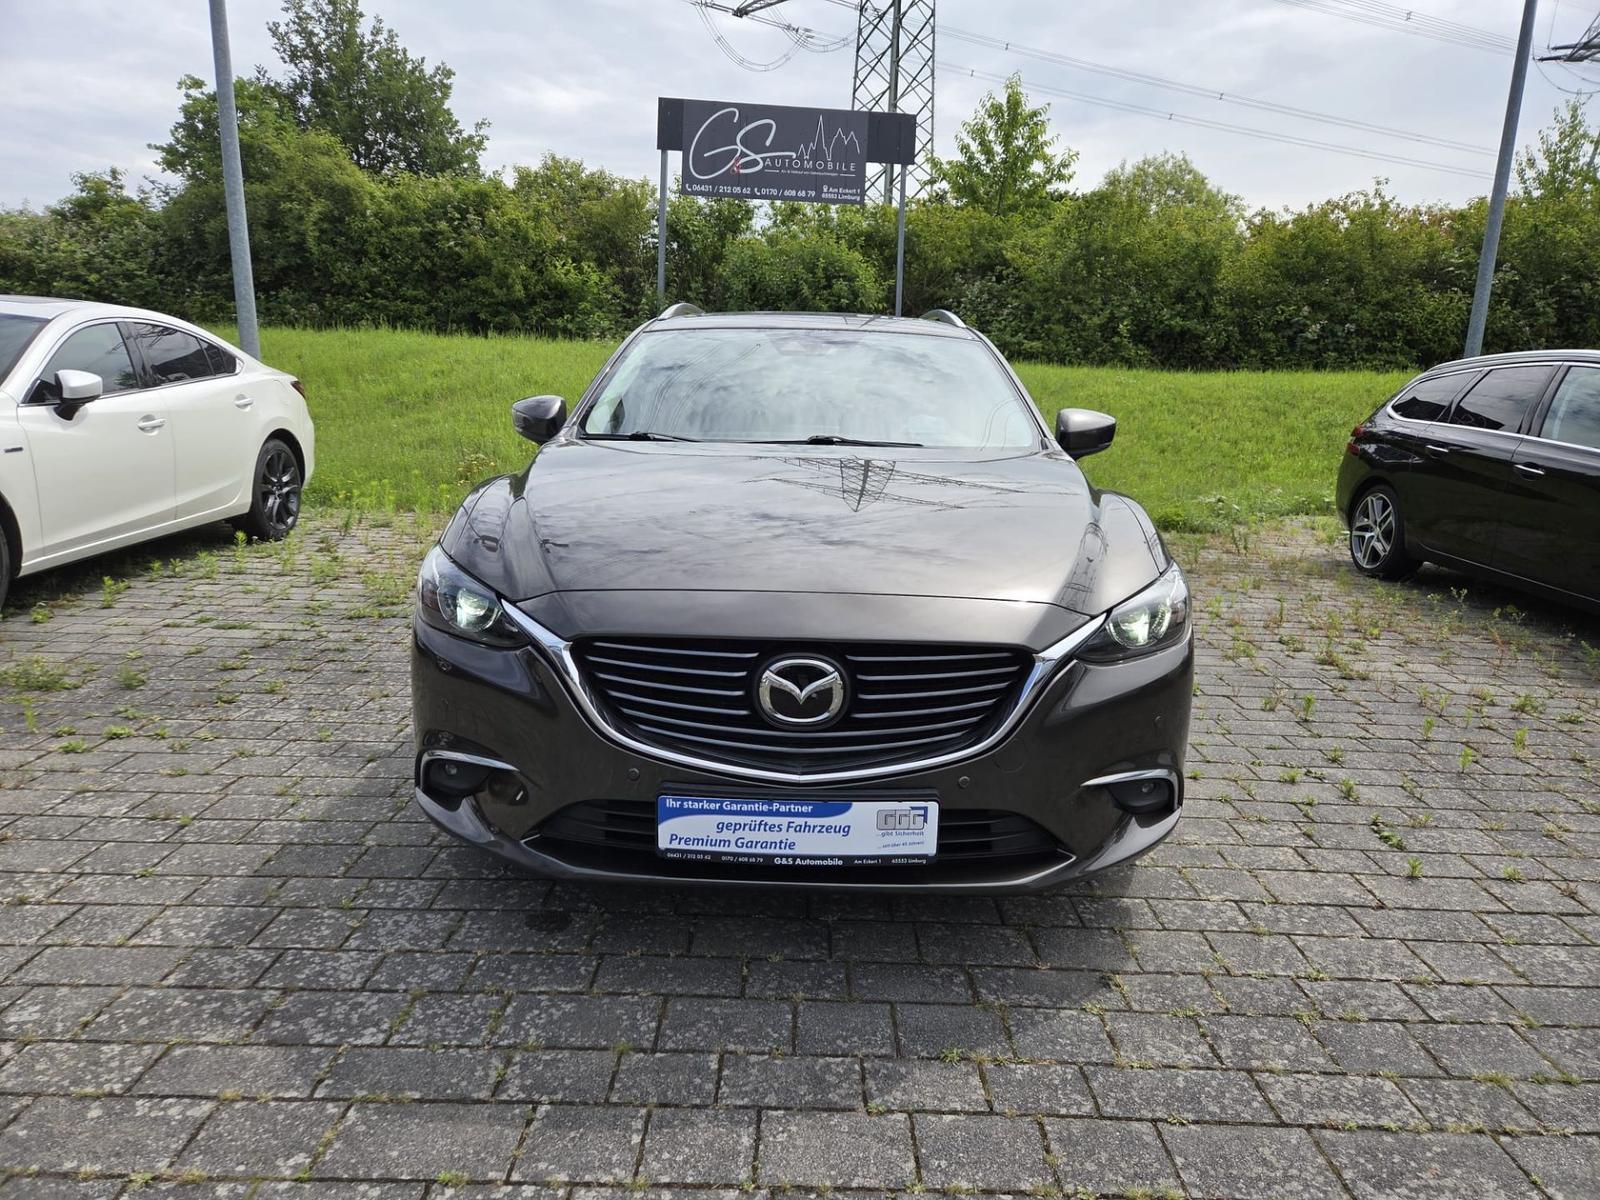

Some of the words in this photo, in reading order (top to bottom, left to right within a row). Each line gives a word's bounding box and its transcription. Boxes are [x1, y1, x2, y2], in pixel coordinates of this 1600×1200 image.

[764, 158, 856, 172] AUTOMOBILE
[692, 183, 712, 192] 06431
[719, 185, 731, 193] 212
[838, 193, 860, 201] Limburg
[666, 798, 681, 808] Ihr
[683, 800, 720, 810] starker
[722, 801, 813, 813] Garantie-Partner
[716, 820, 783, 833] geprüftes
[786, 821, 851, 837] Fahrzeug
[669, 833, 731, 848] Premium
[735, 837, 796, 850] Garantie
[774, 857, 793, 865] G&S
[795, 858, 843, 866] Automobile
